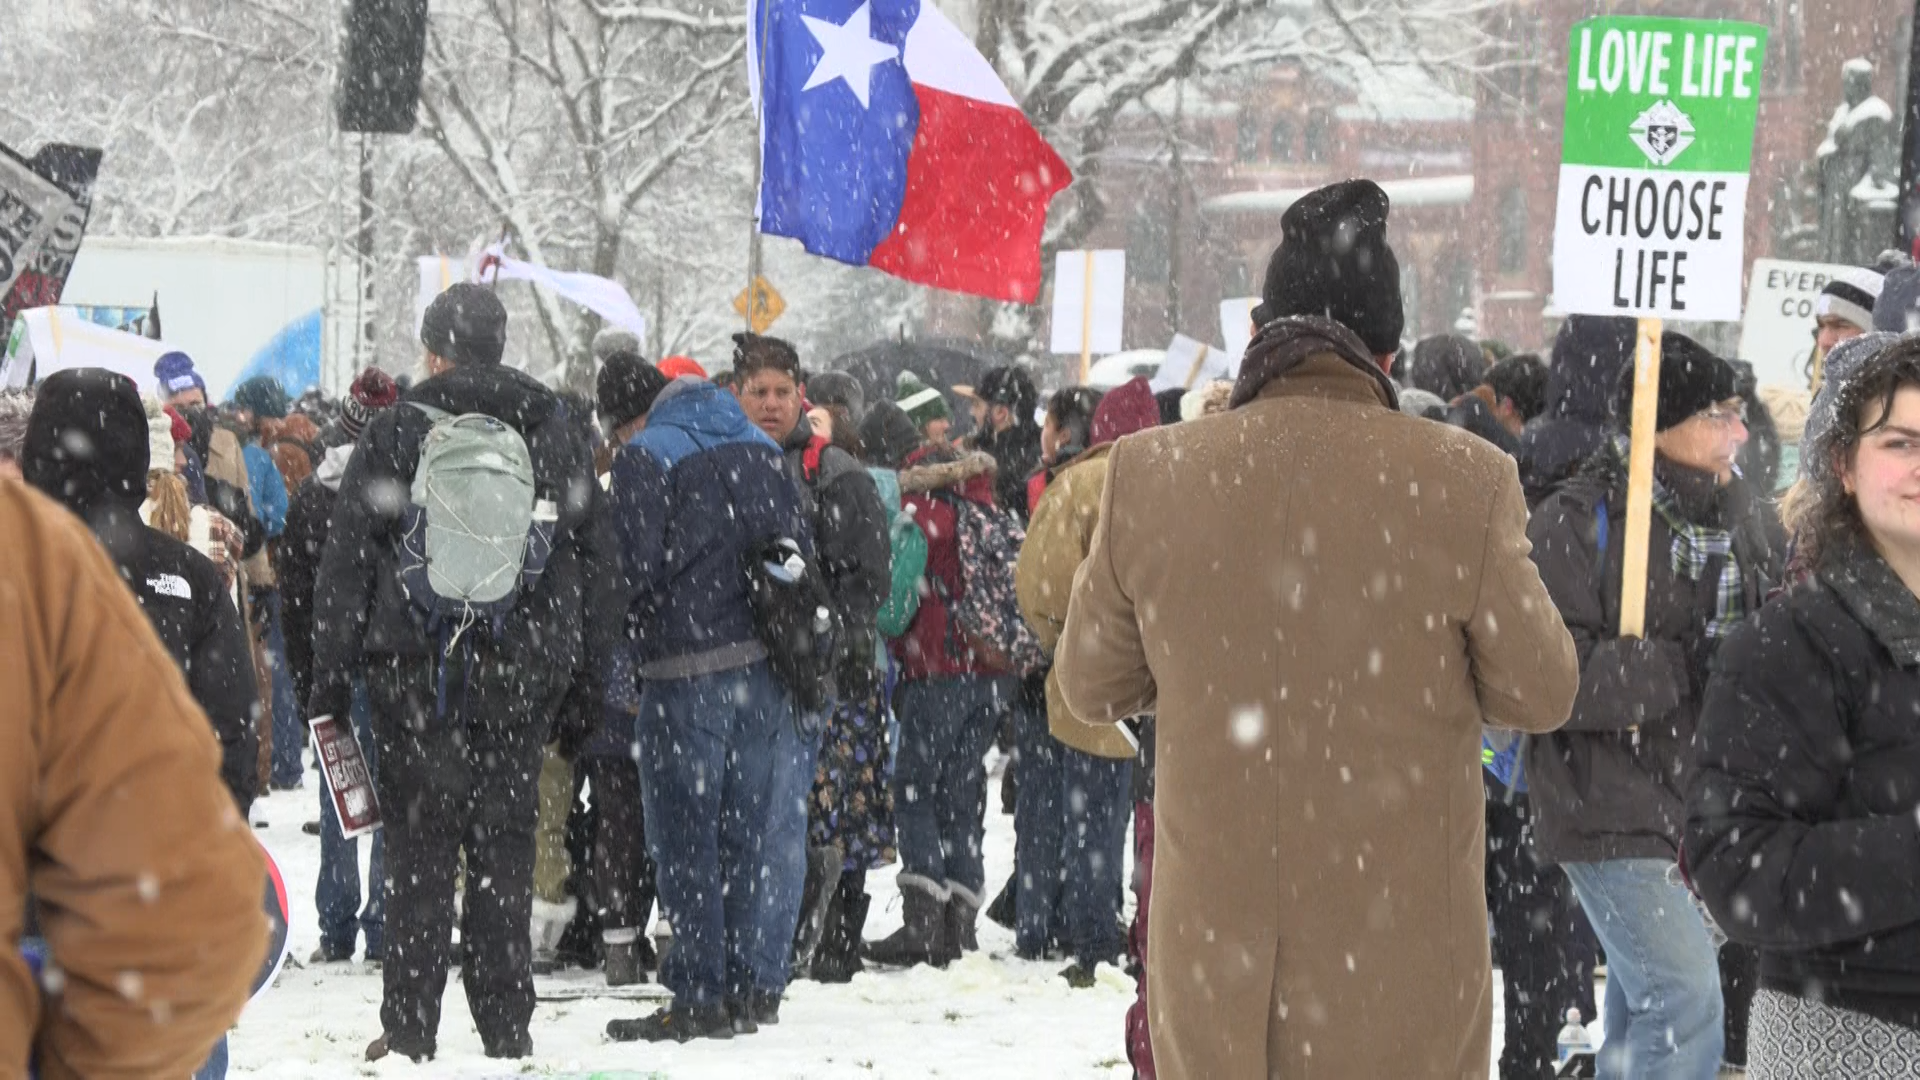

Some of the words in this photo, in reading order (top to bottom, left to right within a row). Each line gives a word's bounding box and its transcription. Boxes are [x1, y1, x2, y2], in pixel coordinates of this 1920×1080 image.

[1577, 27, 1673, 96] LOVE
[1680, 32, 1757, 99] LIFE
[1581, 174, 1727, 241] CHOOSE
[1613, 247, 1688, 311] LIFE
